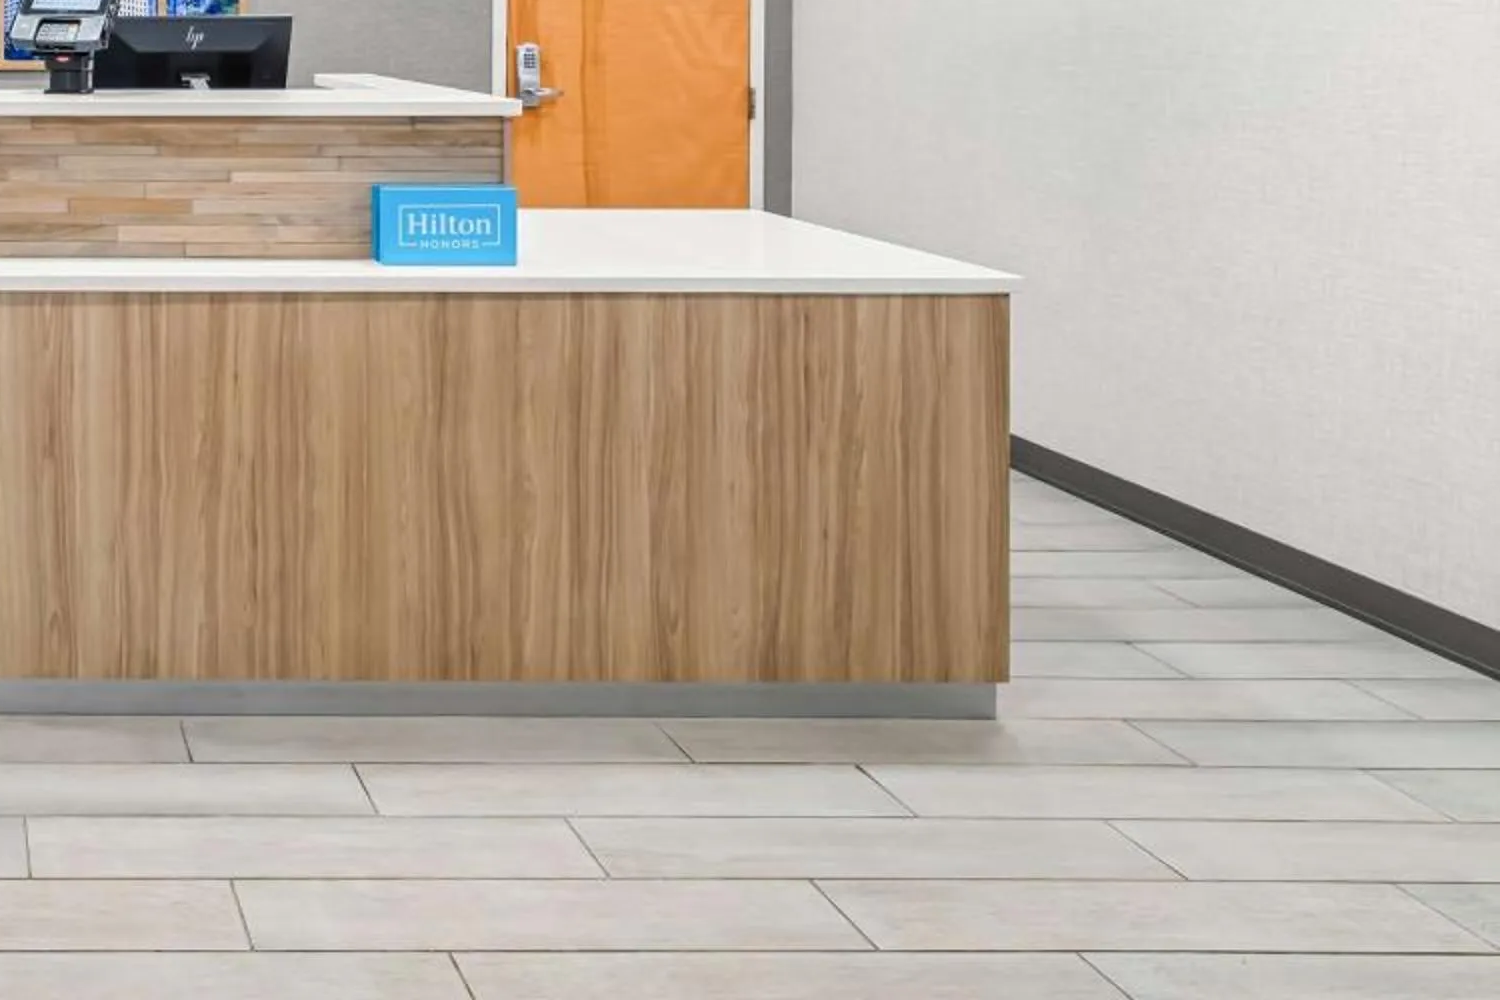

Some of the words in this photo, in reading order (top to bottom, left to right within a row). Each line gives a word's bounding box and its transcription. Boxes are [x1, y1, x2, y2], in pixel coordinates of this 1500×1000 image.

[185, 25, 205, 50] hp
[407, 212, 492, 236] Hilton
[419, 239, 480, 249] HONORS
